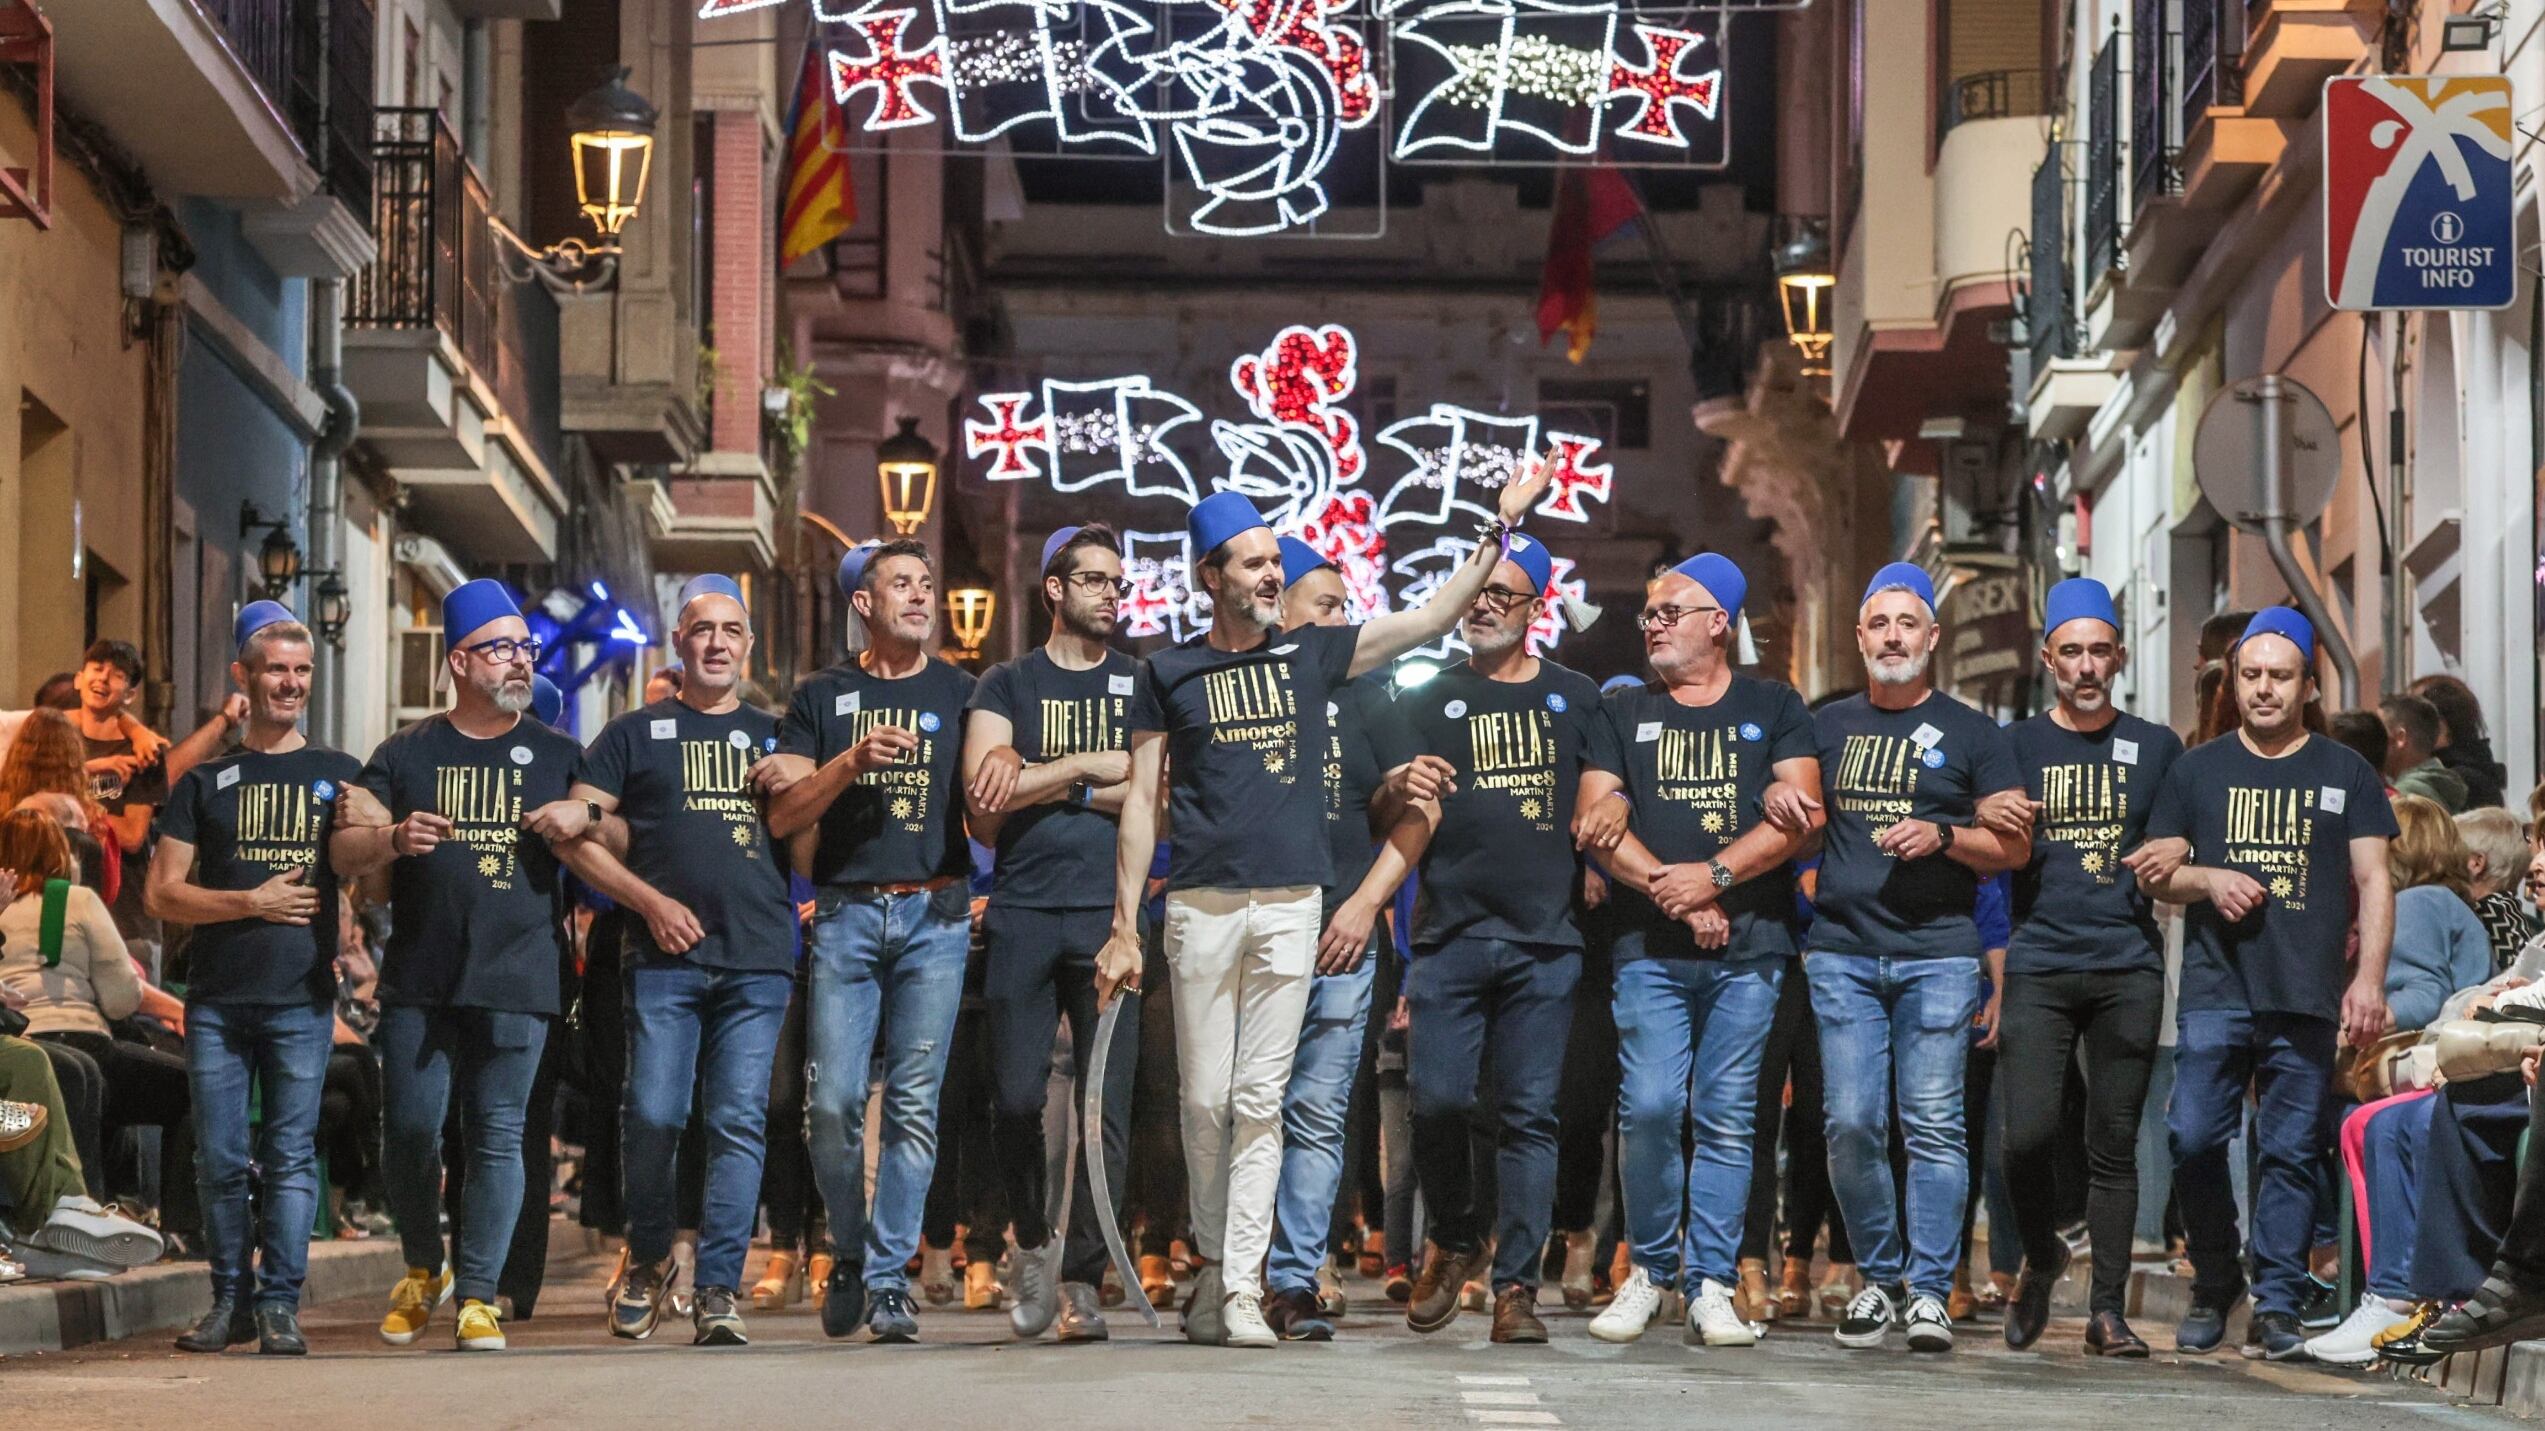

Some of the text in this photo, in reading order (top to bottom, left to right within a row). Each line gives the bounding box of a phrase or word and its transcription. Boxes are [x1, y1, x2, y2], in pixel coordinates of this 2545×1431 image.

[2401, 247, 2495, 268] TOURIST
[2421, 269, 2475, 288] INFO
[1202, 663, 1284, 724] IDELLA
[1278, 662, 1297, 715] DE MIS
[1114, 698, 1124, 717] DE
[1041, 697, 1109, 758] IDELLA
[1468, 709, 1543, 772] IDELLA
[1541, 710, 1556, 764] DE MIS
[922, 739, 933, 764] MIS
[1330, 735, 1342, 758] MIS
[1657, 728, 1725, 781] IDELLA
[1727, 726, 1738, 778] DE MIS
[1834, 735, 1909, 794] IDELLA
[2116, 765, 2127, 784] DE
[436, 766, 506, 823] IDELLA
[511, 768, 522, 822] DE MIS
[884, 785, 918, 796] MARTÍN
[917, 787, 929, 820] MARTA
[1510, 786, 1544, 796] MARTÍN
[1546, 787, 1554, 818] MARTA
[1691, 799, 1727, 809] MARTÍN
[2041, 763, 2112, 823] IDELLA
[237, 783, 306, 842] IDELLA
[1535, 822, 1553, 831] 2024
[1728, 800, 1738, 832] MARTA
[1865, 813, 1900, 823] MARTÍN
[2225, 787, 2298, 846] IDELLA
[2301, 789, 2314, 845] DE MIS
[904, 822, 924, 833] 2024
[470, 843, 506, 853] MARTÍN
[2074, 840, 2110, 850] MARTÍN
[2261, 864, 2299, 875] MARTÍN
[491, 879, 512, 890] 2024
[2284, 900, 2306, 911] 2024
